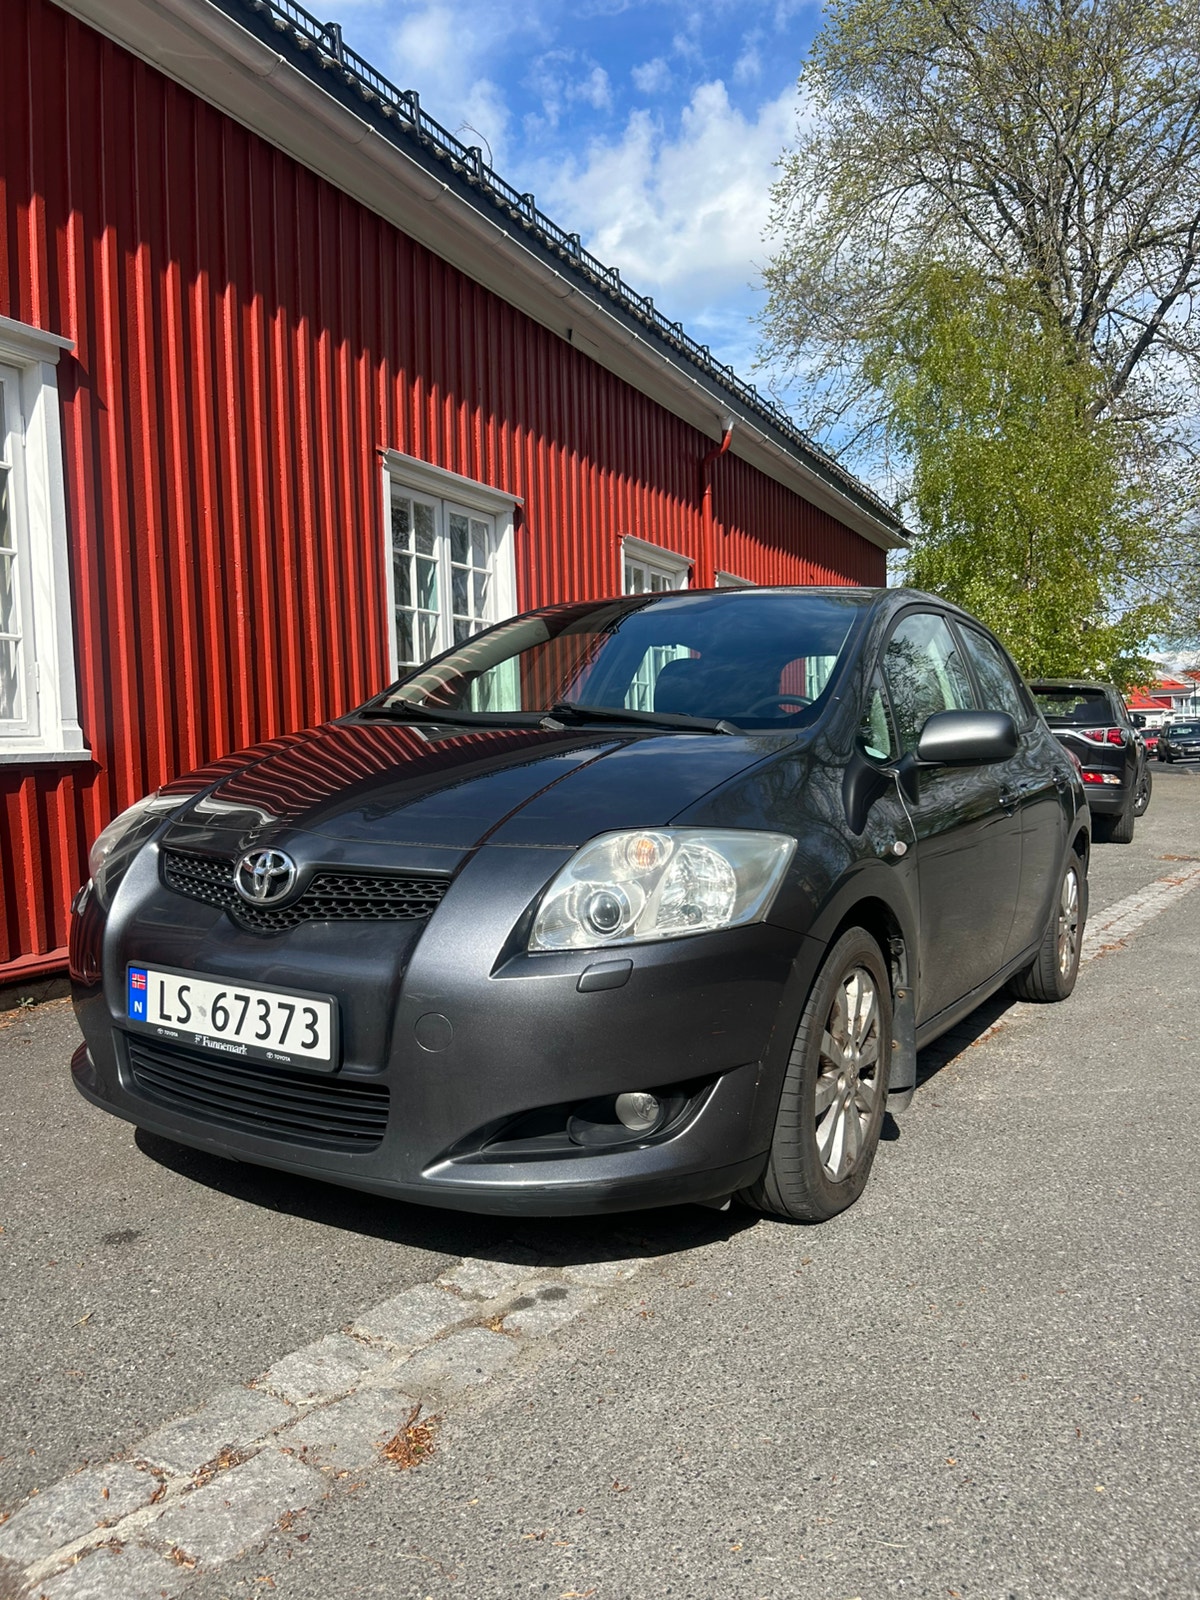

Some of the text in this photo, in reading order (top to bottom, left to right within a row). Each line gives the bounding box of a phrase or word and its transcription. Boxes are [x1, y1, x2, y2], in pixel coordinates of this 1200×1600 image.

[134, 1001, 143, 1014] N
[159, 980, 320, 1050] LS 67373
[202, 1036, 248, 1054] Funnemark
[274, 1054, 291, 1062] TOYOTA
